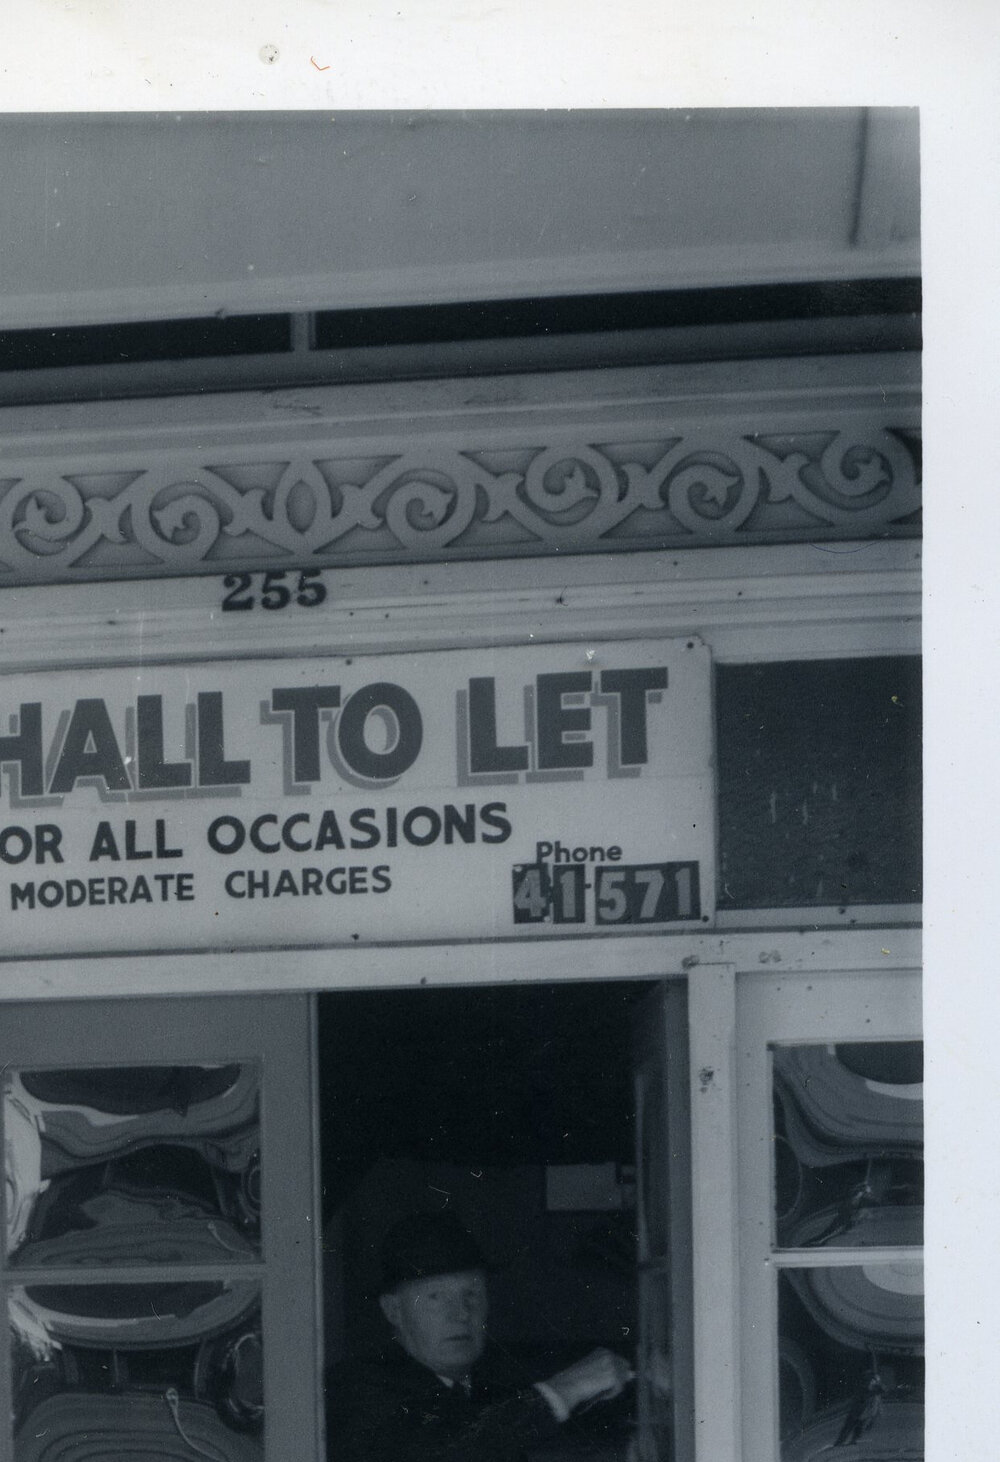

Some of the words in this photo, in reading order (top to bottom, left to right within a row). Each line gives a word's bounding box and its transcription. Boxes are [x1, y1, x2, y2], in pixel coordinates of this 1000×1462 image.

[222, 570, 327, 612] 255
[259, 682, 424, 796] TO
[457, 667, 669, 787] LET
[89, 818, 183, 862] ALL
[207, 802, 513, 856] OCCASIONS
[536, 840, 623, 864] Phone
[10, 873, 195, 911] MODERATE
[225, 865, 393, 899] CHARGES
